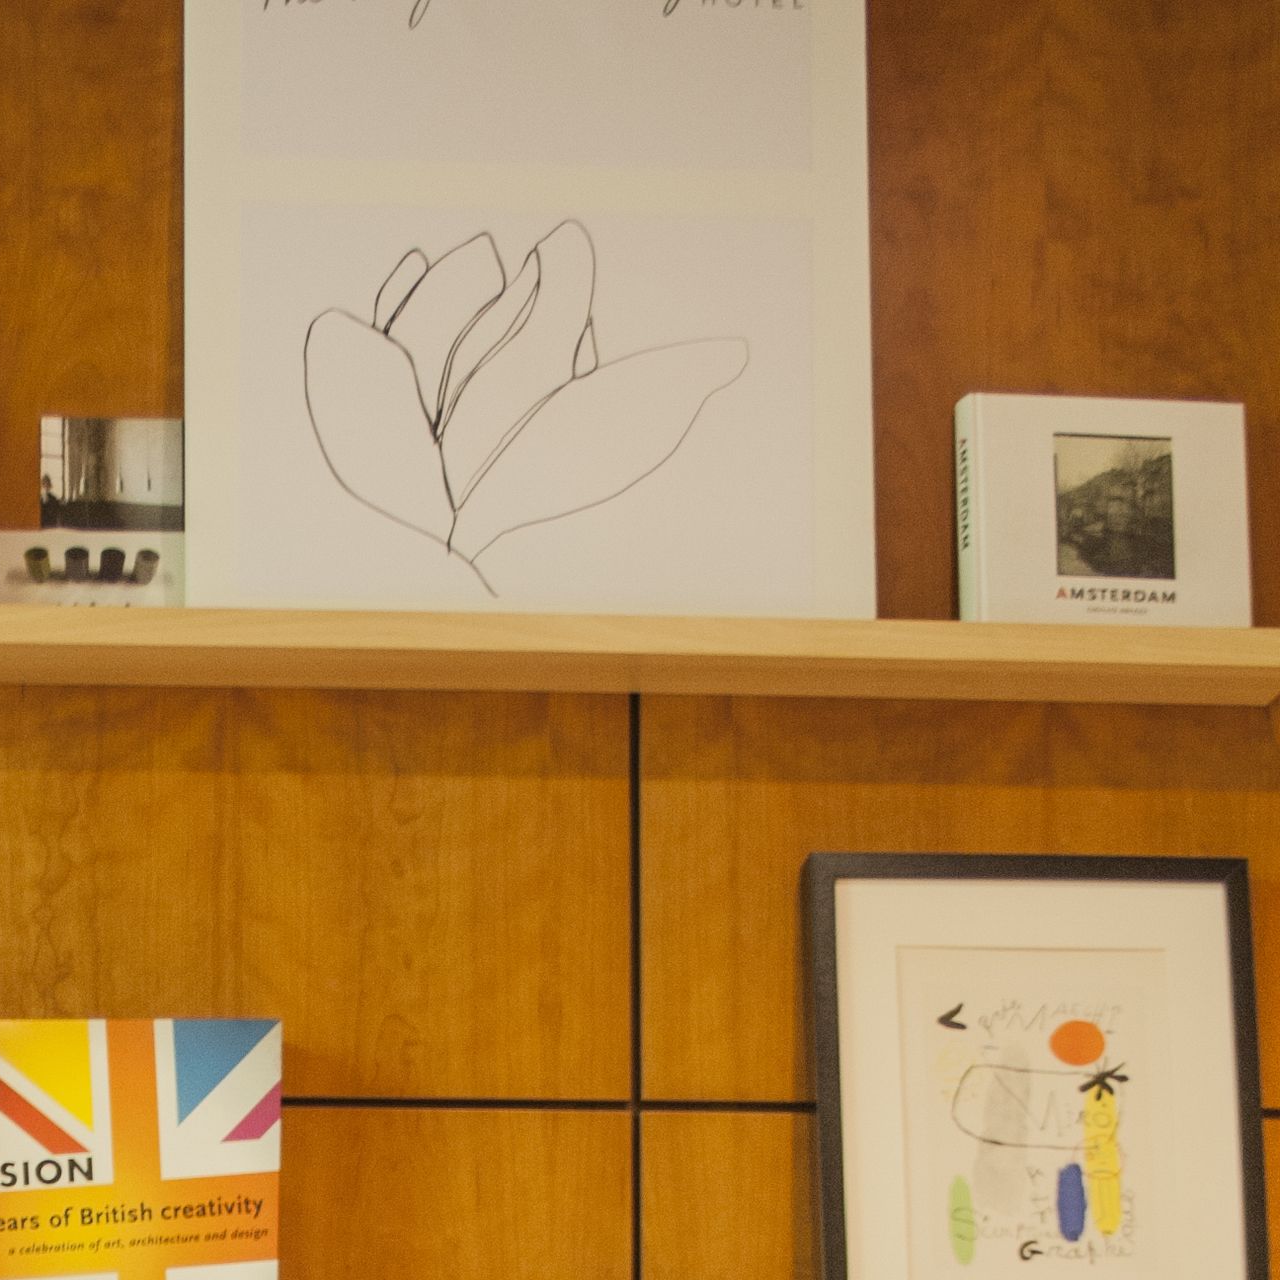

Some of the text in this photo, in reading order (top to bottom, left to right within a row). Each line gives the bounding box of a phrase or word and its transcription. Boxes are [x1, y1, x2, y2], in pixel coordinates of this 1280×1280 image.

[1056, 586, 1176, 603] AMSTERDAM
[49, 1205, 73, 1228] of
[80, 1201, 153, 1226] British
[160, 1195, 264, 1220] creativity
[19, 1241, 85, 1256] celebration
[89, 1239, 103, 1253] of
[129, 1233, 201, 1248] architecture
[204, 1229, 228, 1242] and
[230, 1227, 270, 1242] design
